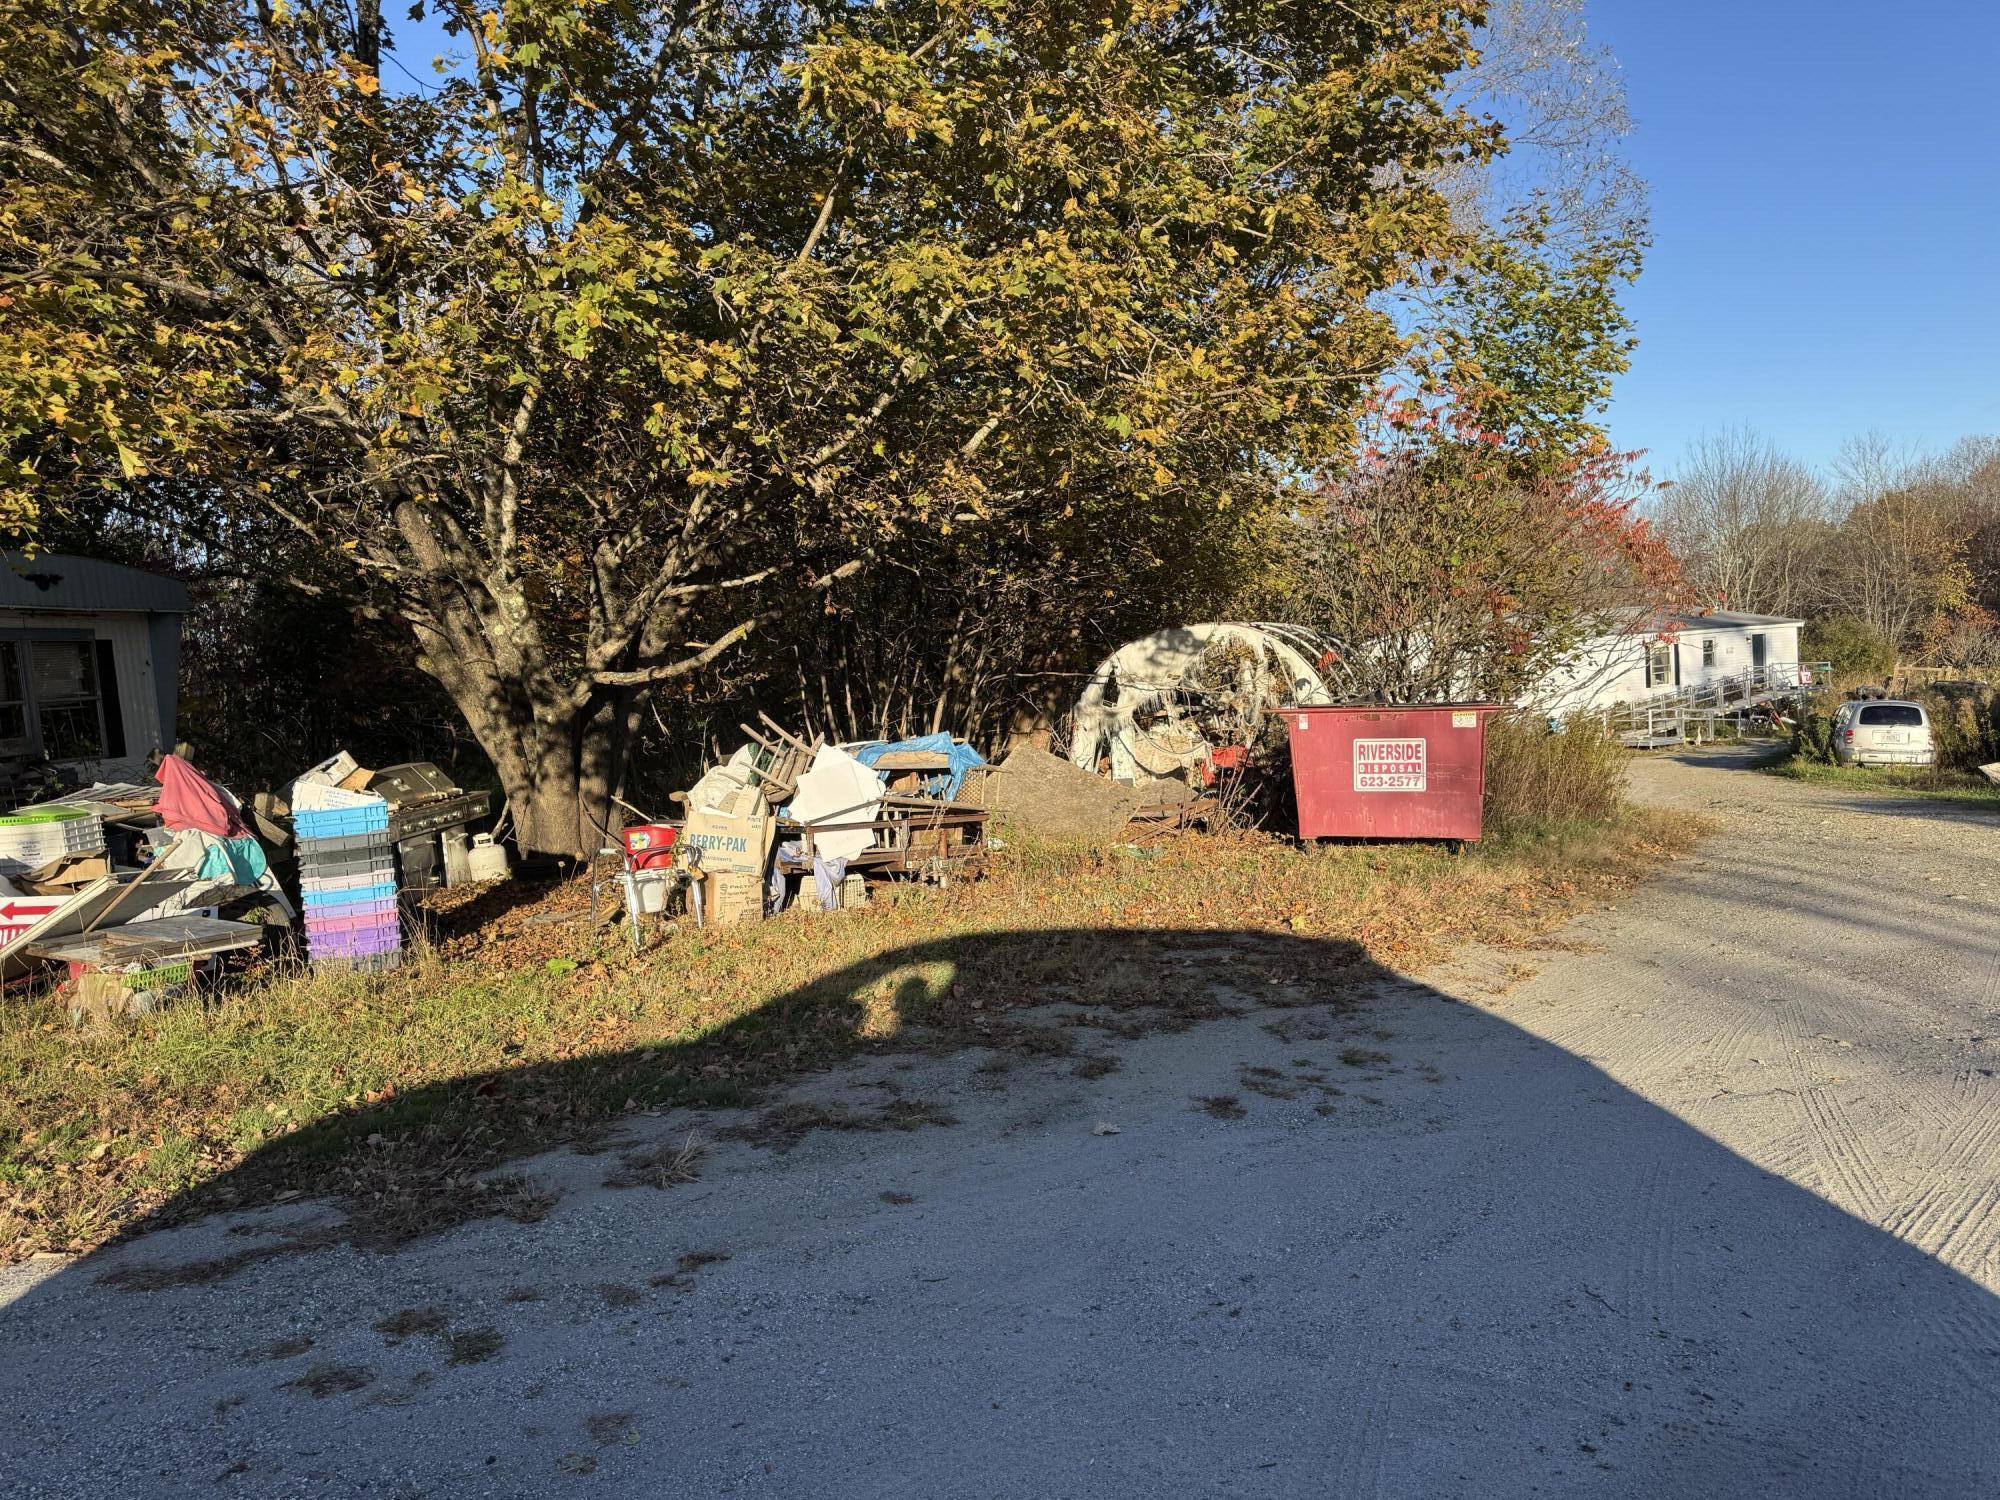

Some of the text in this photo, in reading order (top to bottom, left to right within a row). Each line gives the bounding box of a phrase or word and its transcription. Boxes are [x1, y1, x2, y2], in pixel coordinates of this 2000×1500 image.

[1358, 744, 1422, 760] RIVERSIDE
[1360, 764, 1421, 773] DISPOSAL
[690, 833, 748, 853] BERRY-PAK
